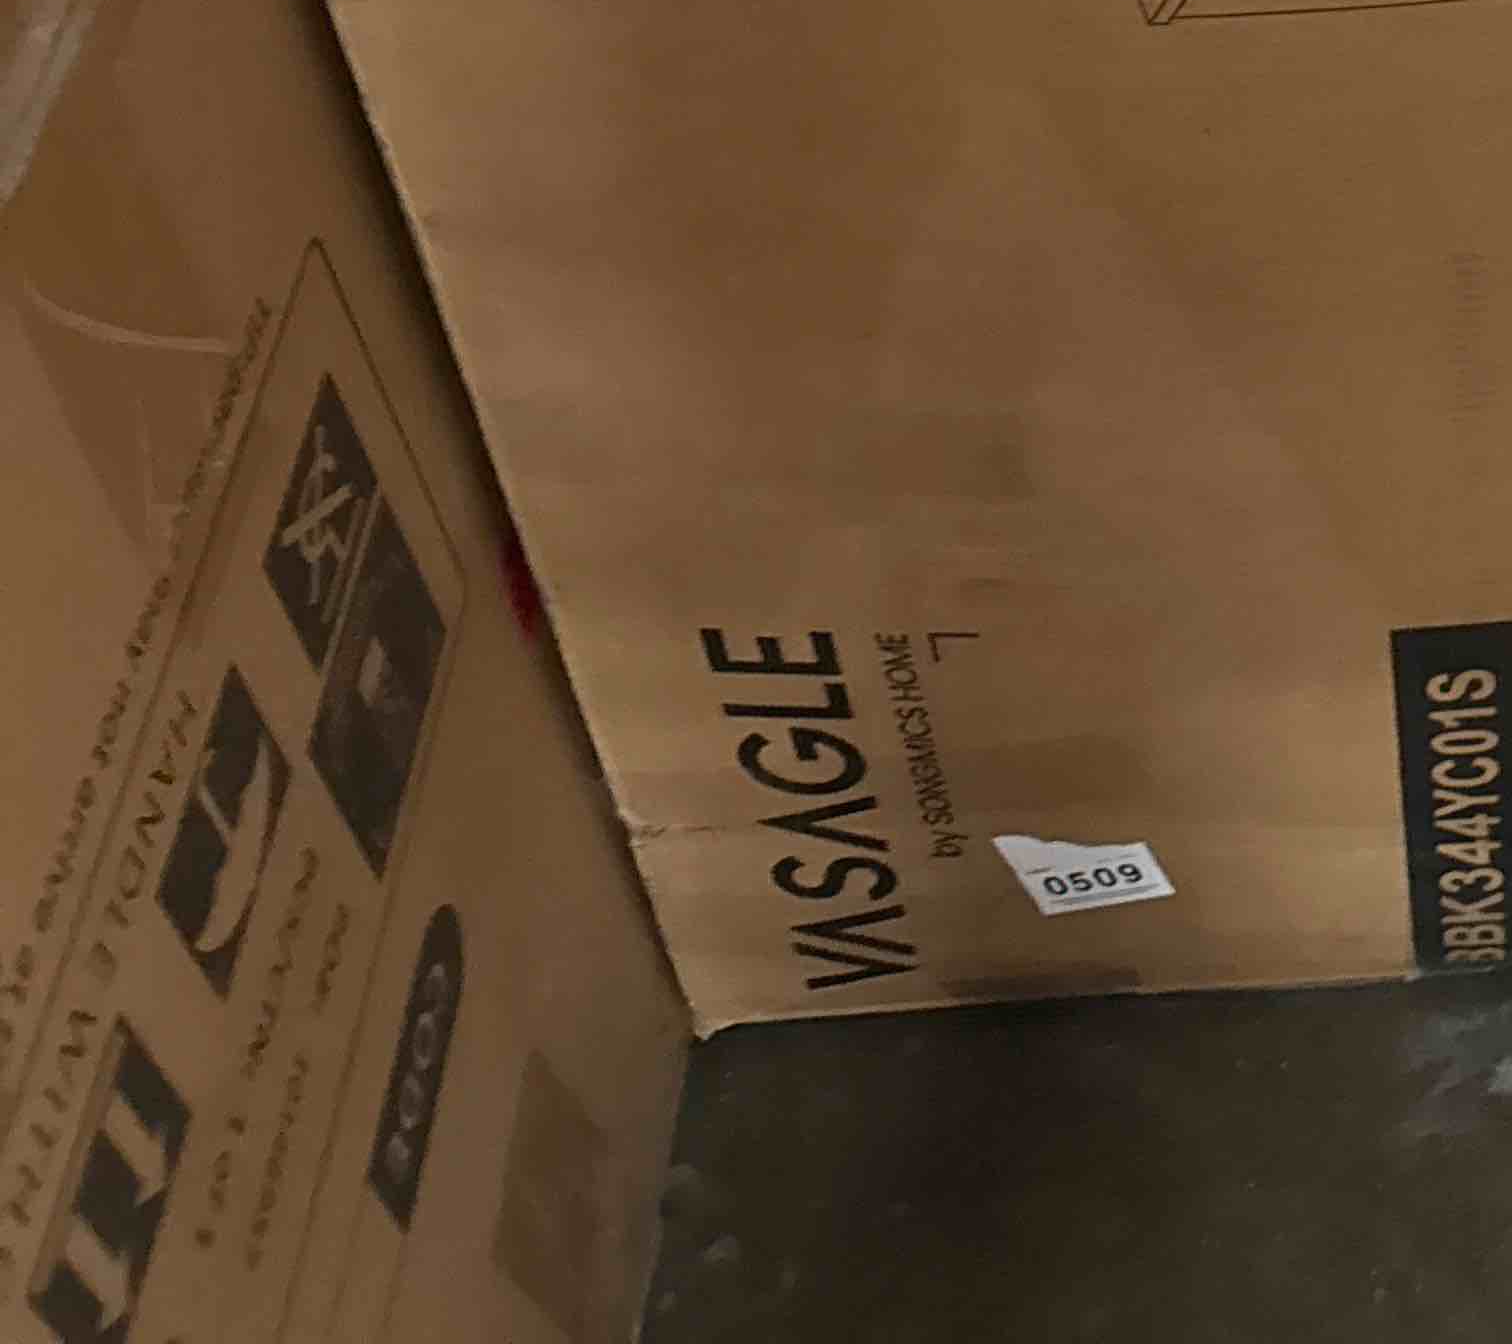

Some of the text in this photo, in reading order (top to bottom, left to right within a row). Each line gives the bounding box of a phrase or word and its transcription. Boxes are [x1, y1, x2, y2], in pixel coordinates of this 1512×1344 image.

[700, 627, 920, 991] VASAGLE
[873, 631, 968, 860] by SONGMICS HOME
[1042, 862, 1144, 896] 0509
[1, 690, 201, 1230] HANDLE WITH
